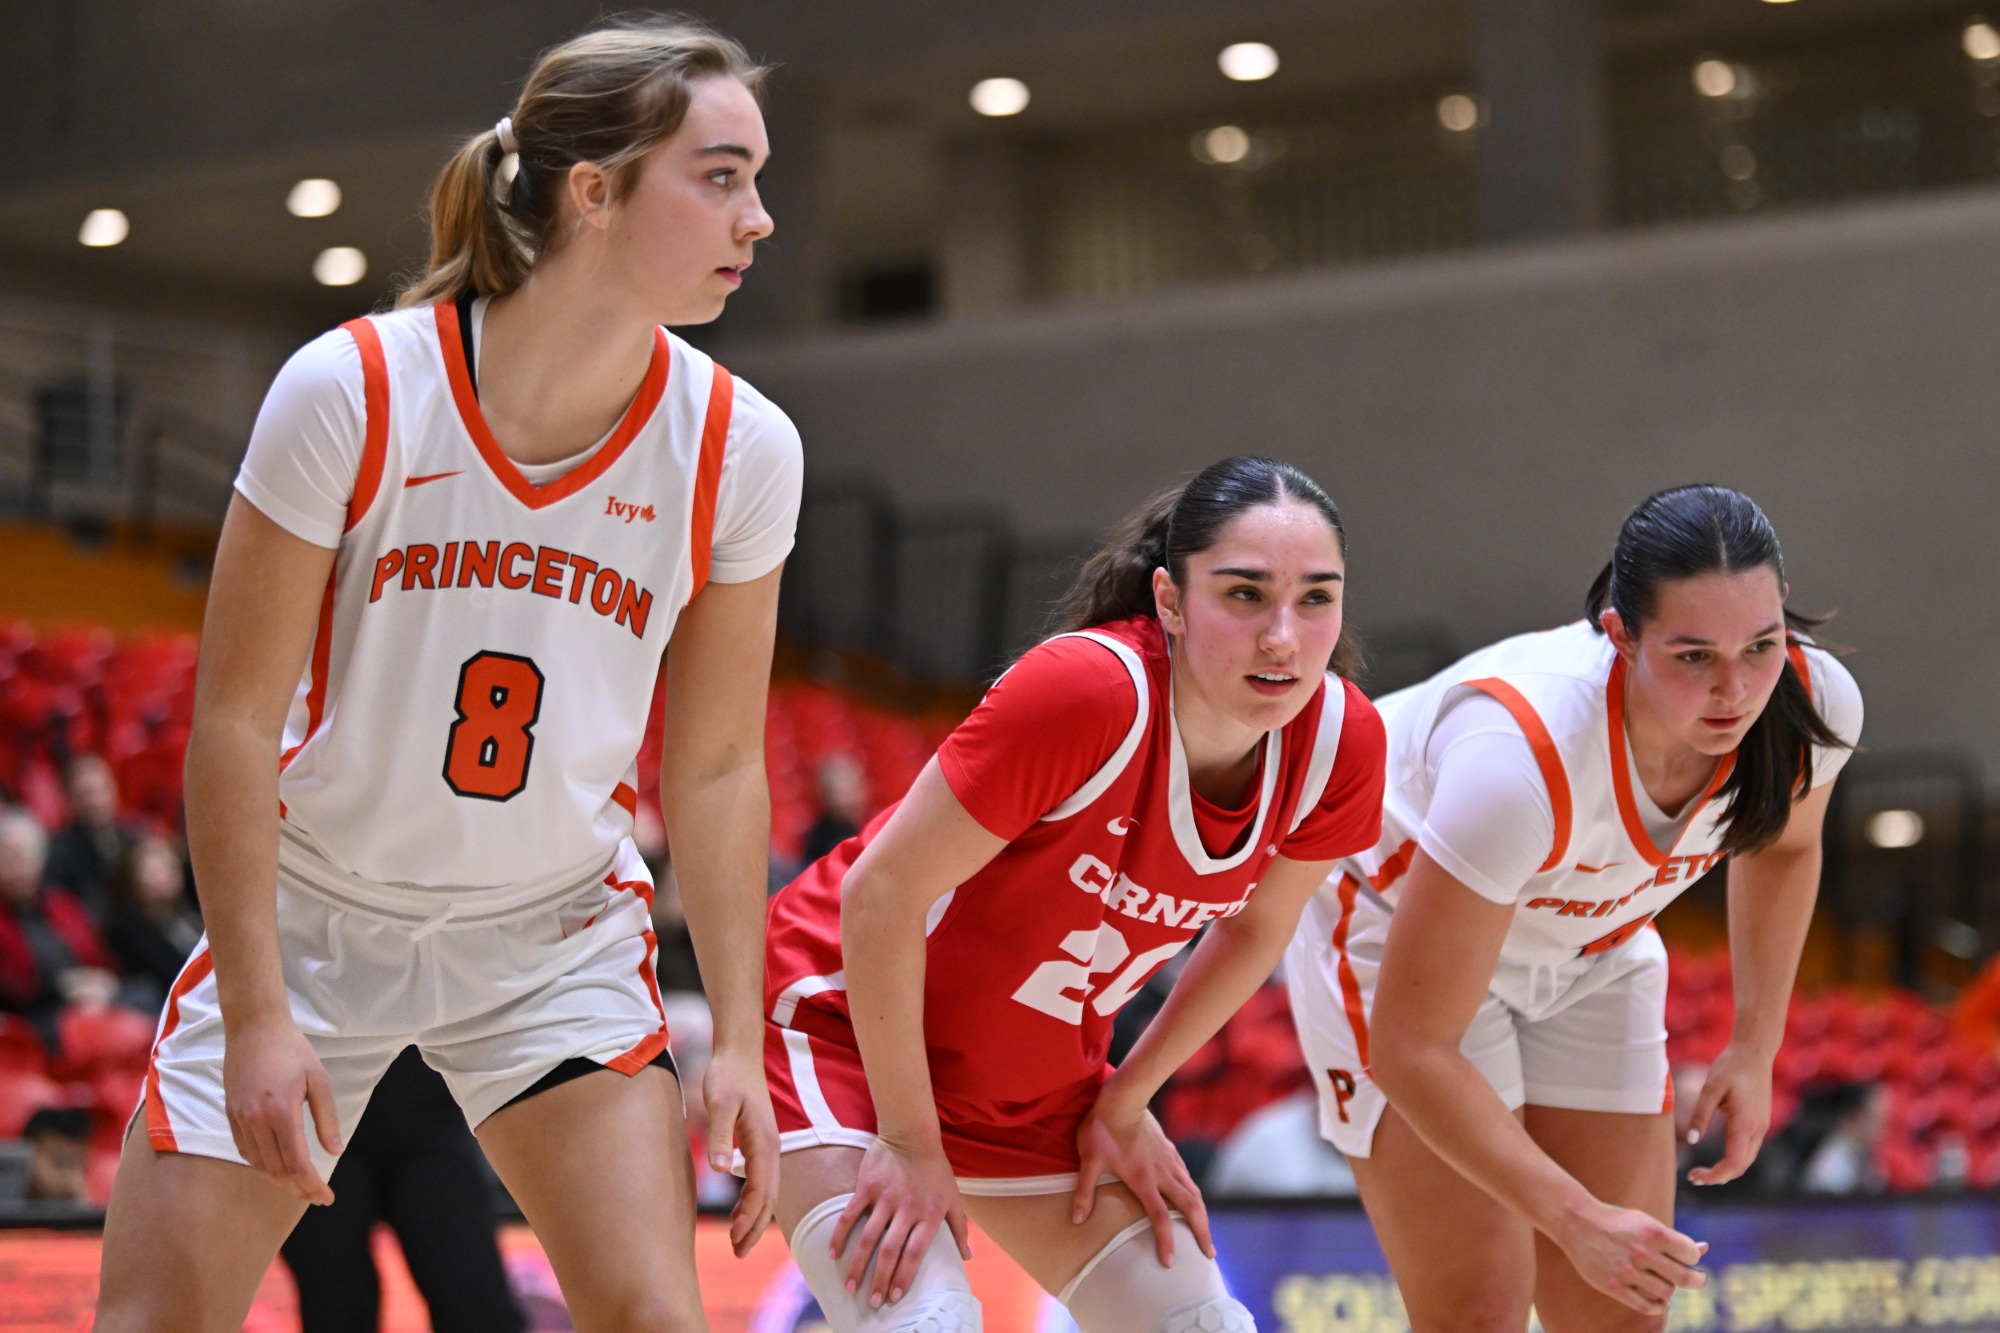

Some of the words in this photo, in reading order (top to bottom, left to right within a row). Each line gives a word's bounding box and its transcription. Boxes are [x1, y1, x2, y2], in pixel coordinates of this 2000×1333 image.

[604, 496, 640, 524] Ivy
[369, 540, 654, 640] PRINCETON
[442, 650, 546, 803] 8
[1010, 920, 1194, 1026] 20
